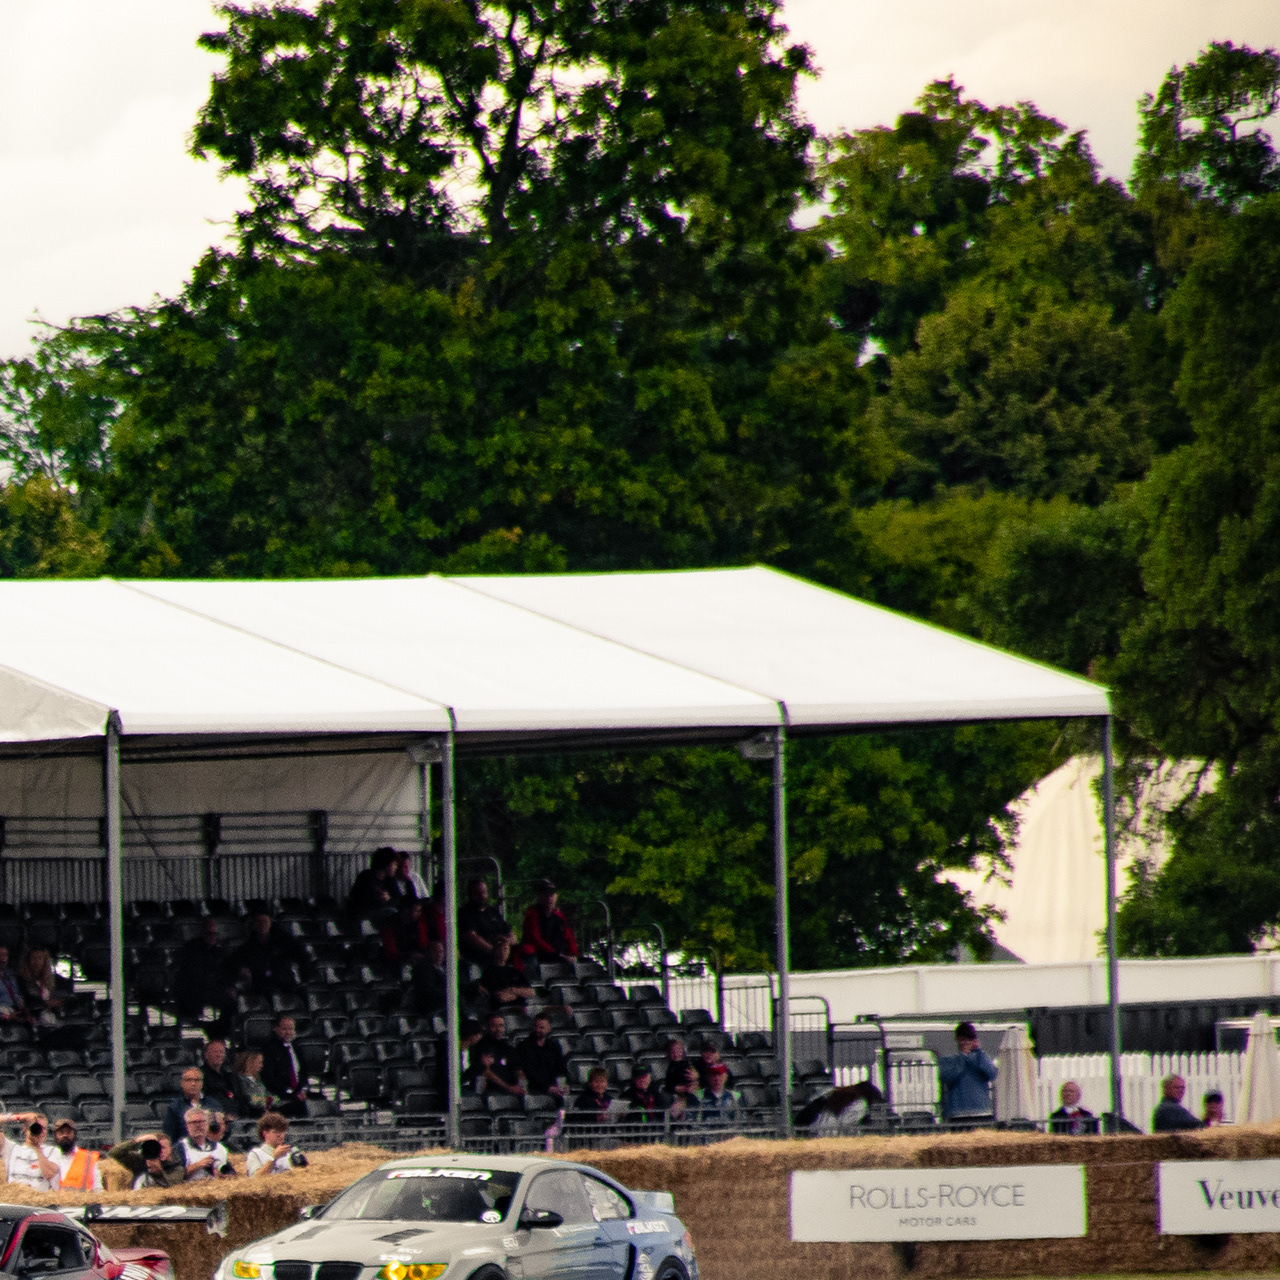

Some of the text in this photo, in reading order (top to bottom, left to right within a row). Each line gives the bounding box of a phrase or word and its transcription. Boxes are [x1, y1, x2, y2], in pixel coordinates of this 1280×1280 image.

[850, 1184, 1025, 1210] ROLLS-ROYCE
[899, 1216, 978, 1227] MOTOR CARS
